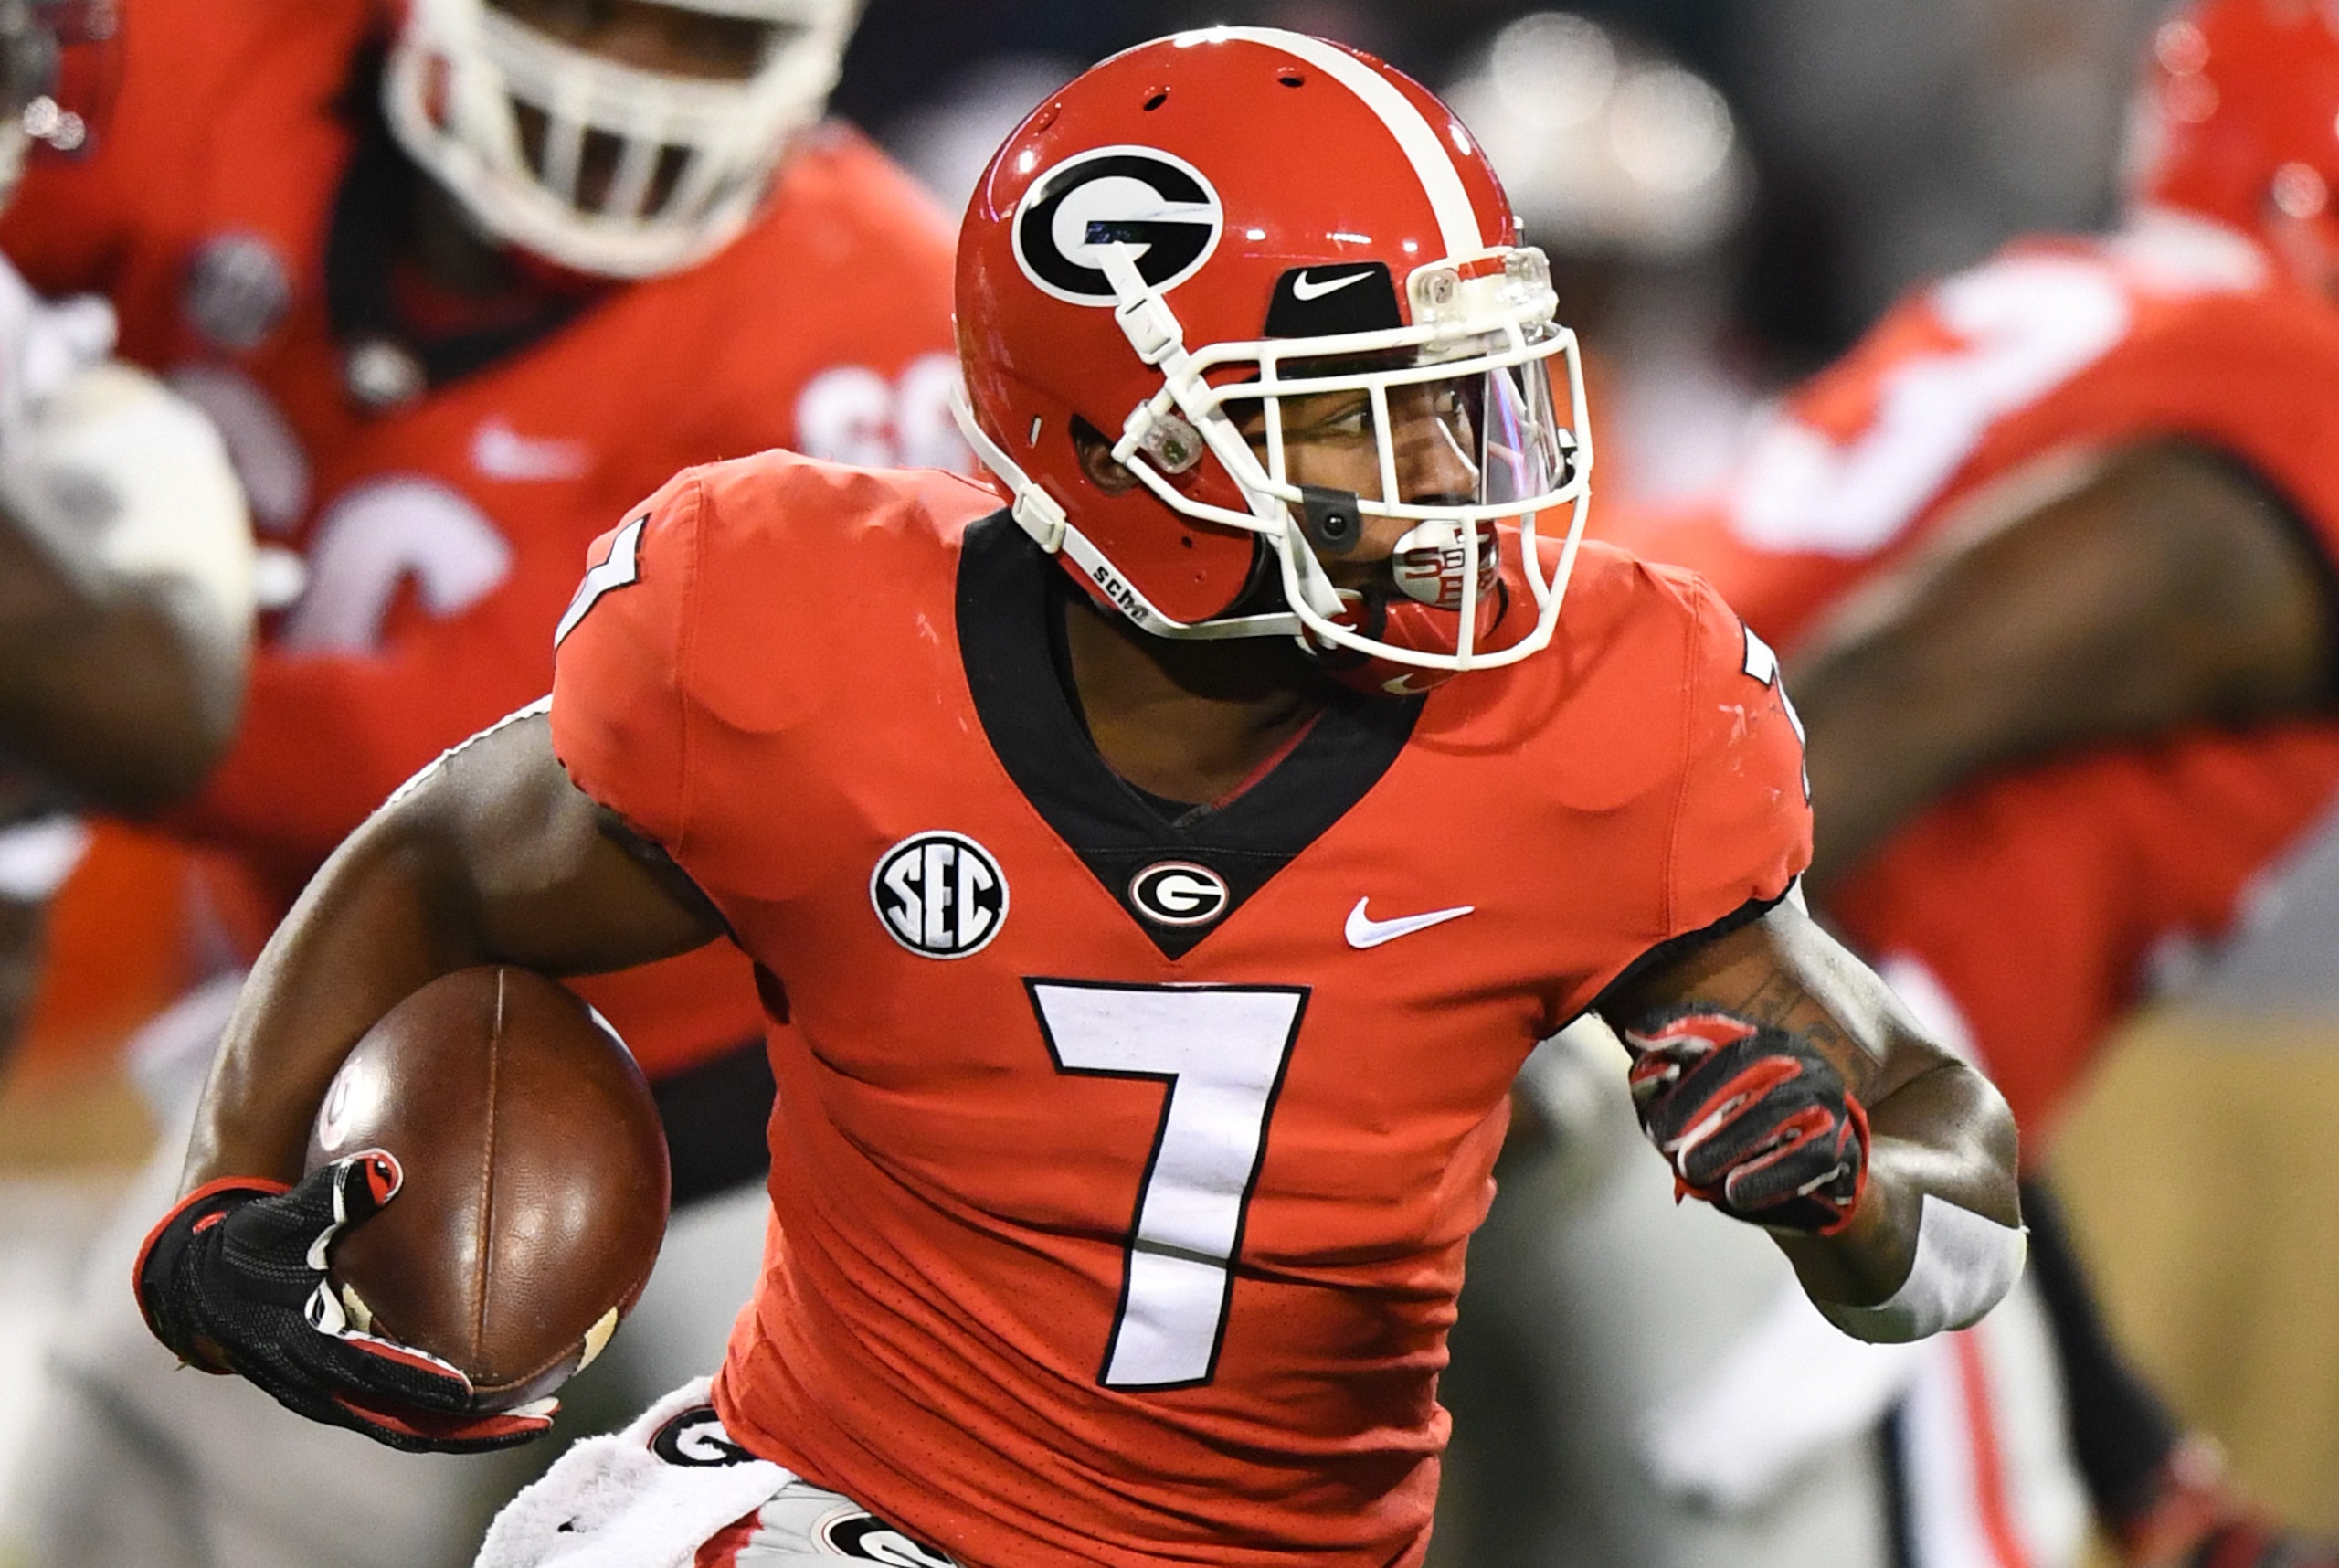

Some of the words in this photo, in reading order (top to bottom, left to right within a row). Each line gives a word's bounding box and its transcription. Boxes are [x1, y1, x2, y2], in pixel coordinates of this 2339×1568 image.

[1019, 154, 1214, 297] G
[884, 843, 994, 948] SEC
[1137, 867, 1222, 919] G
[1021, 977, 1312, 1392] 7
